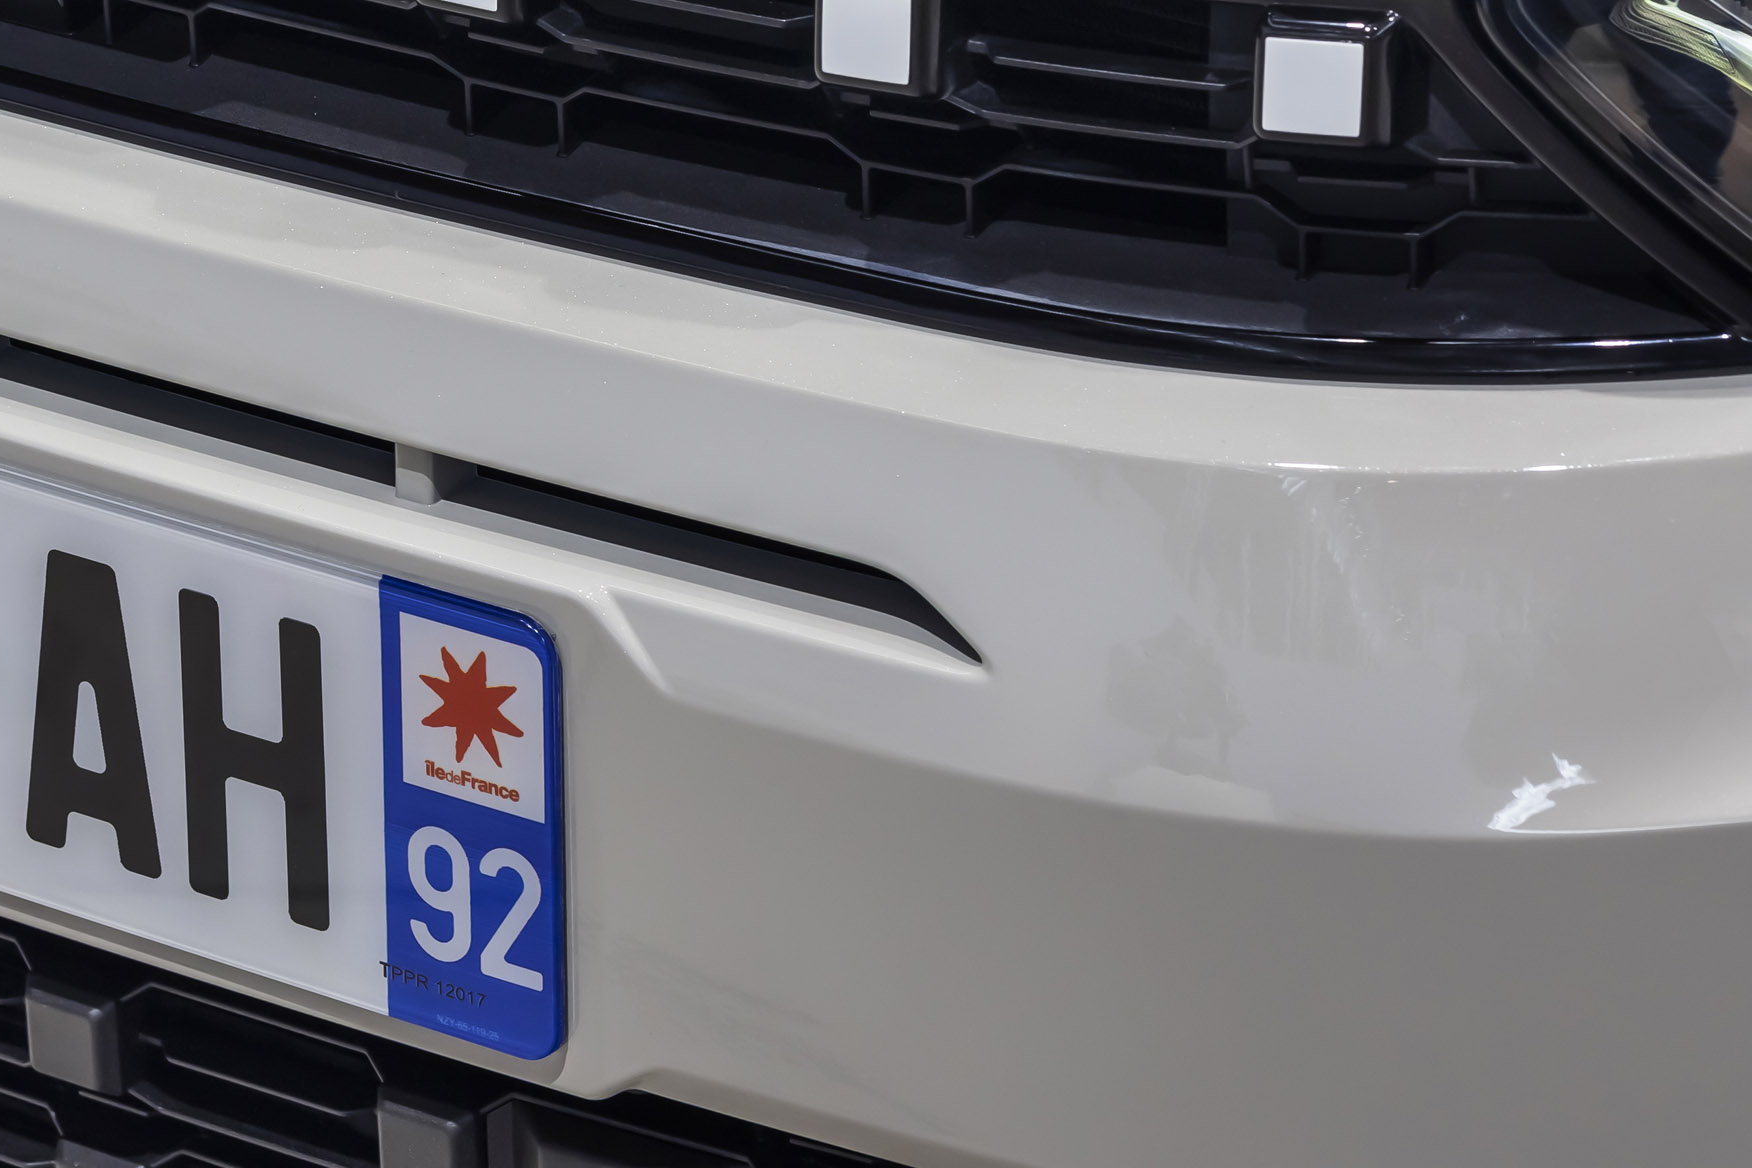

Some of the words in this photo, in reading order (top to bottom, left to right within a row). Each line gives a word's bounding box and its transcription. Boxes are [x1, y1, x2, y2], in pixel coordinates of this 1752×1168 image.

[407, 825, 544, 992] 92
[379, 960, 429, 991] TPPR
[436, 980, 486, 1008] 12017
